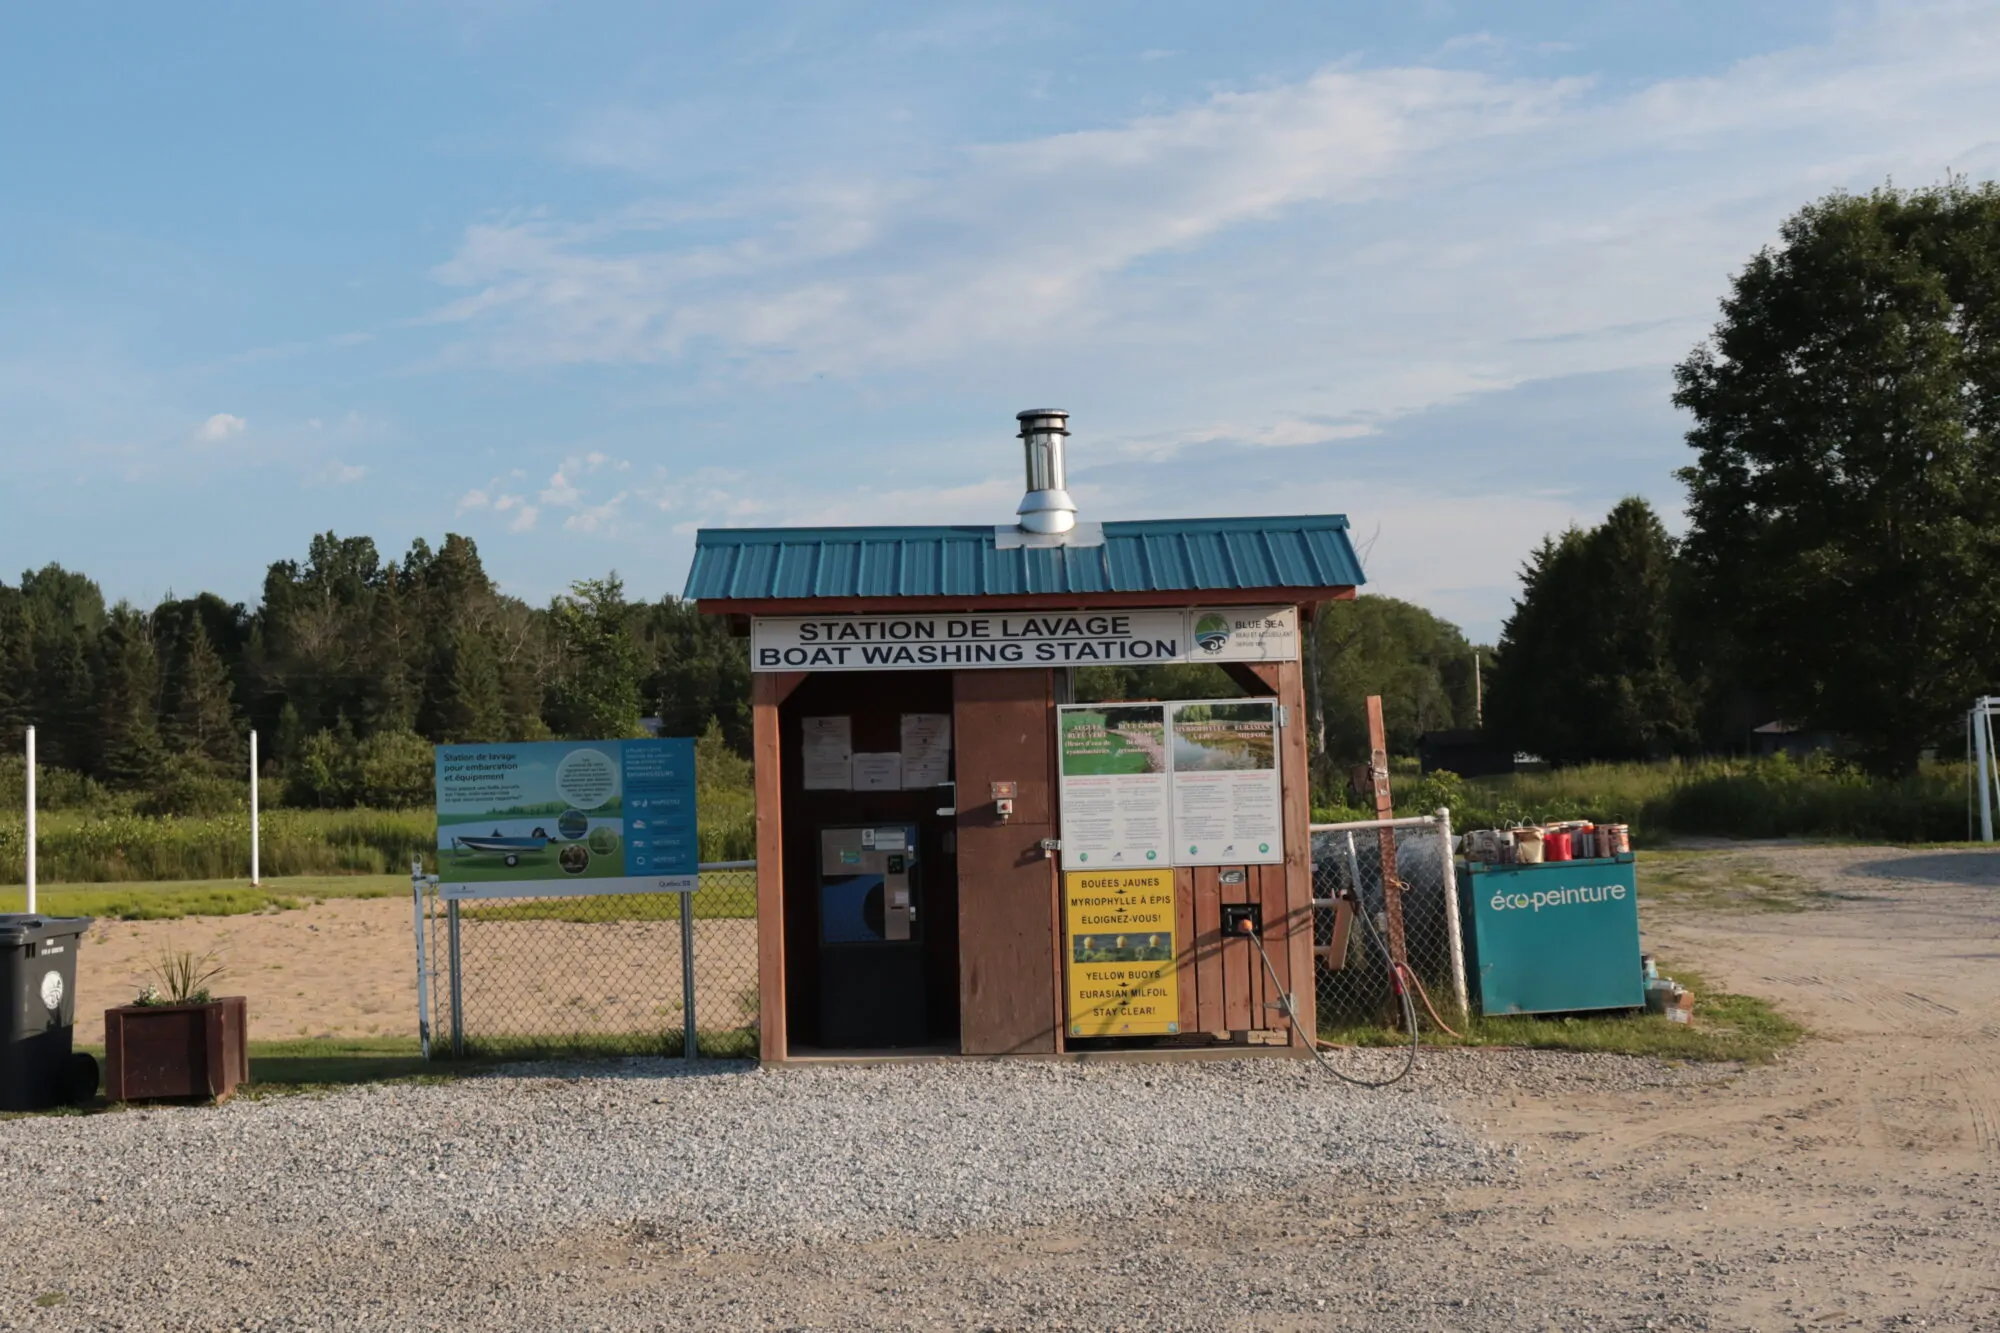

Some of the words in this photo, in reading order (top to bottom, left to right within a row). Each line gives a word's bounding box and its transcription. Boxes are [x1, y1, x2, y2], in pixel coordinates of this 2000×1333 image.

[799, 620, 935, 641] STATION
[947, 619, 990, 639] DE
[1002, 616, 1131, 637] LAVAGE
[1235, 620, 1261, 629] BLUE
[1264, 620, 1284, 628] SEA
[759, 647, 852, 667] BOAT
[861, 644, 1023, 665] WASHING
[1035, 639, 1177, 661] STATION
[444, 753, 474, 761] Station
[489, 753, 516, 761] lavage
[444, 764, 463, 772] pour
[465, 763, 518, 771] embarcation
[454, 773, 504, 782] équipement
[1081, 878, 1119, 888] BOUÉES
[1122, 878, 1159, 887] JAUNES
[1071, 896, 1137, 906] MYRIOPHYLLE
[1149, 894, 1171, 904] ÉPIS
[1490, 884, 1626, 913] éco-peinture
[1086, 971, 1125, 980] YELLOW
[1128, 970, 1161, 979] BUOYS
[1079, 989, 1128, 999] EURASIAN
[1130, 988, 1168, 997] MILFOIL
[1093, 1008, 1118, 1016] STAY
[1120, 1006, 1156, 1015] CLEAR!
